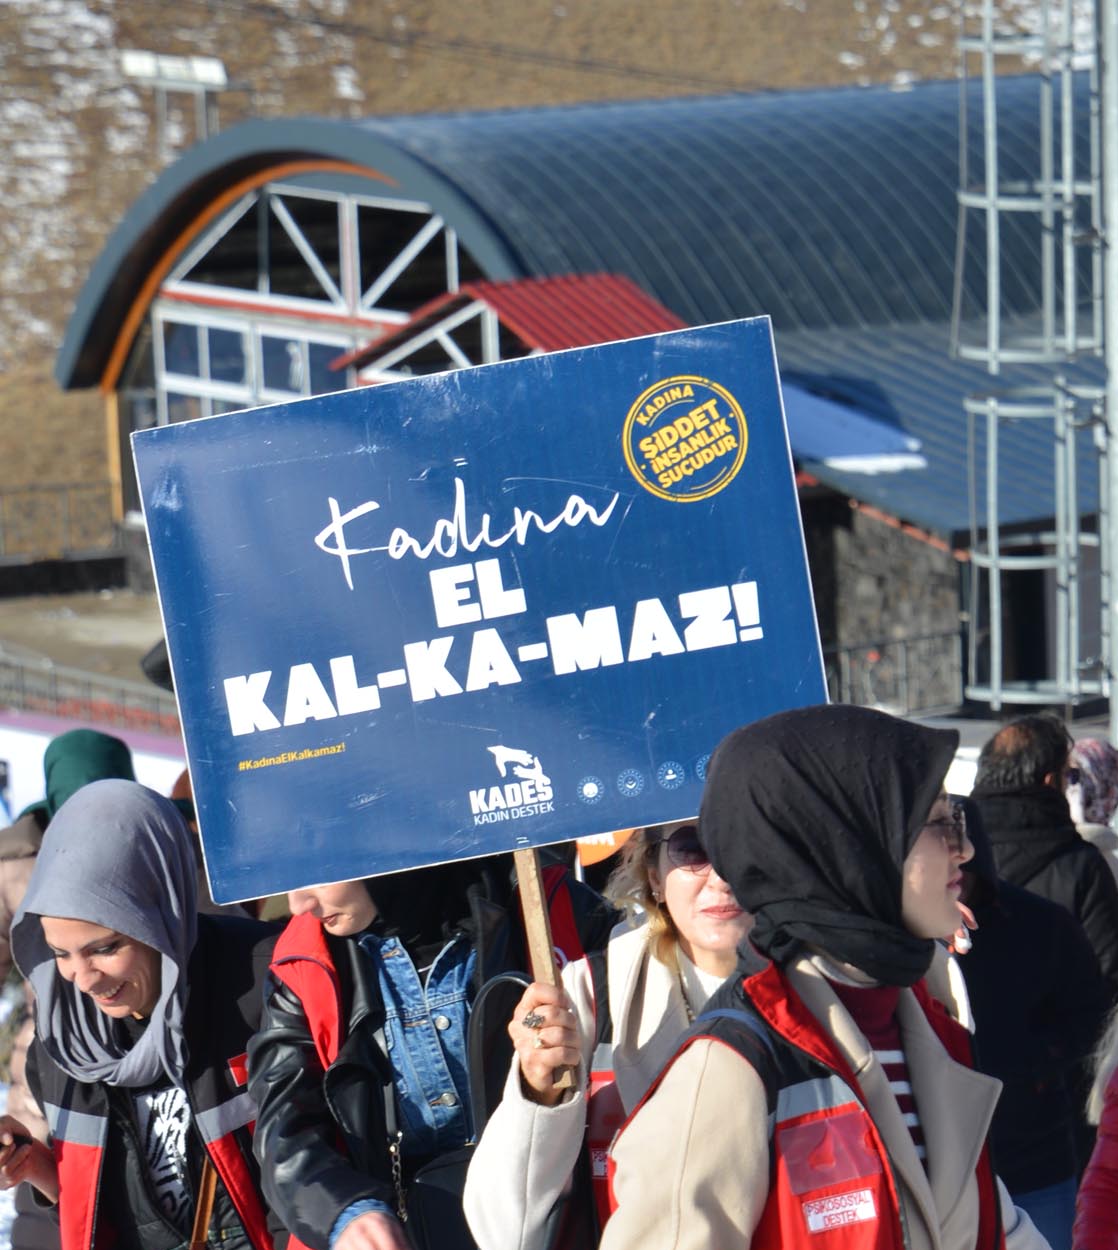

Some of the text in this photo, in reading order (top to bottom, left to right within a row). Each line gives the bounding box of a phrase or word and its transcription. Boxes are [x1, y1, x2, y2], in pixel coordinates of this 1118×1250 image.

[636, 385, 694, 426] KADINA
[658, 434, 738, 489] SUÇUDUR
[429, 558, 527, 628] EL
[223, 581, 764, 737] KAL-KA-MAZ!
[469, 773, 554, 815] KADES
[473, 801, 555, 826] KADIN DESTEK
